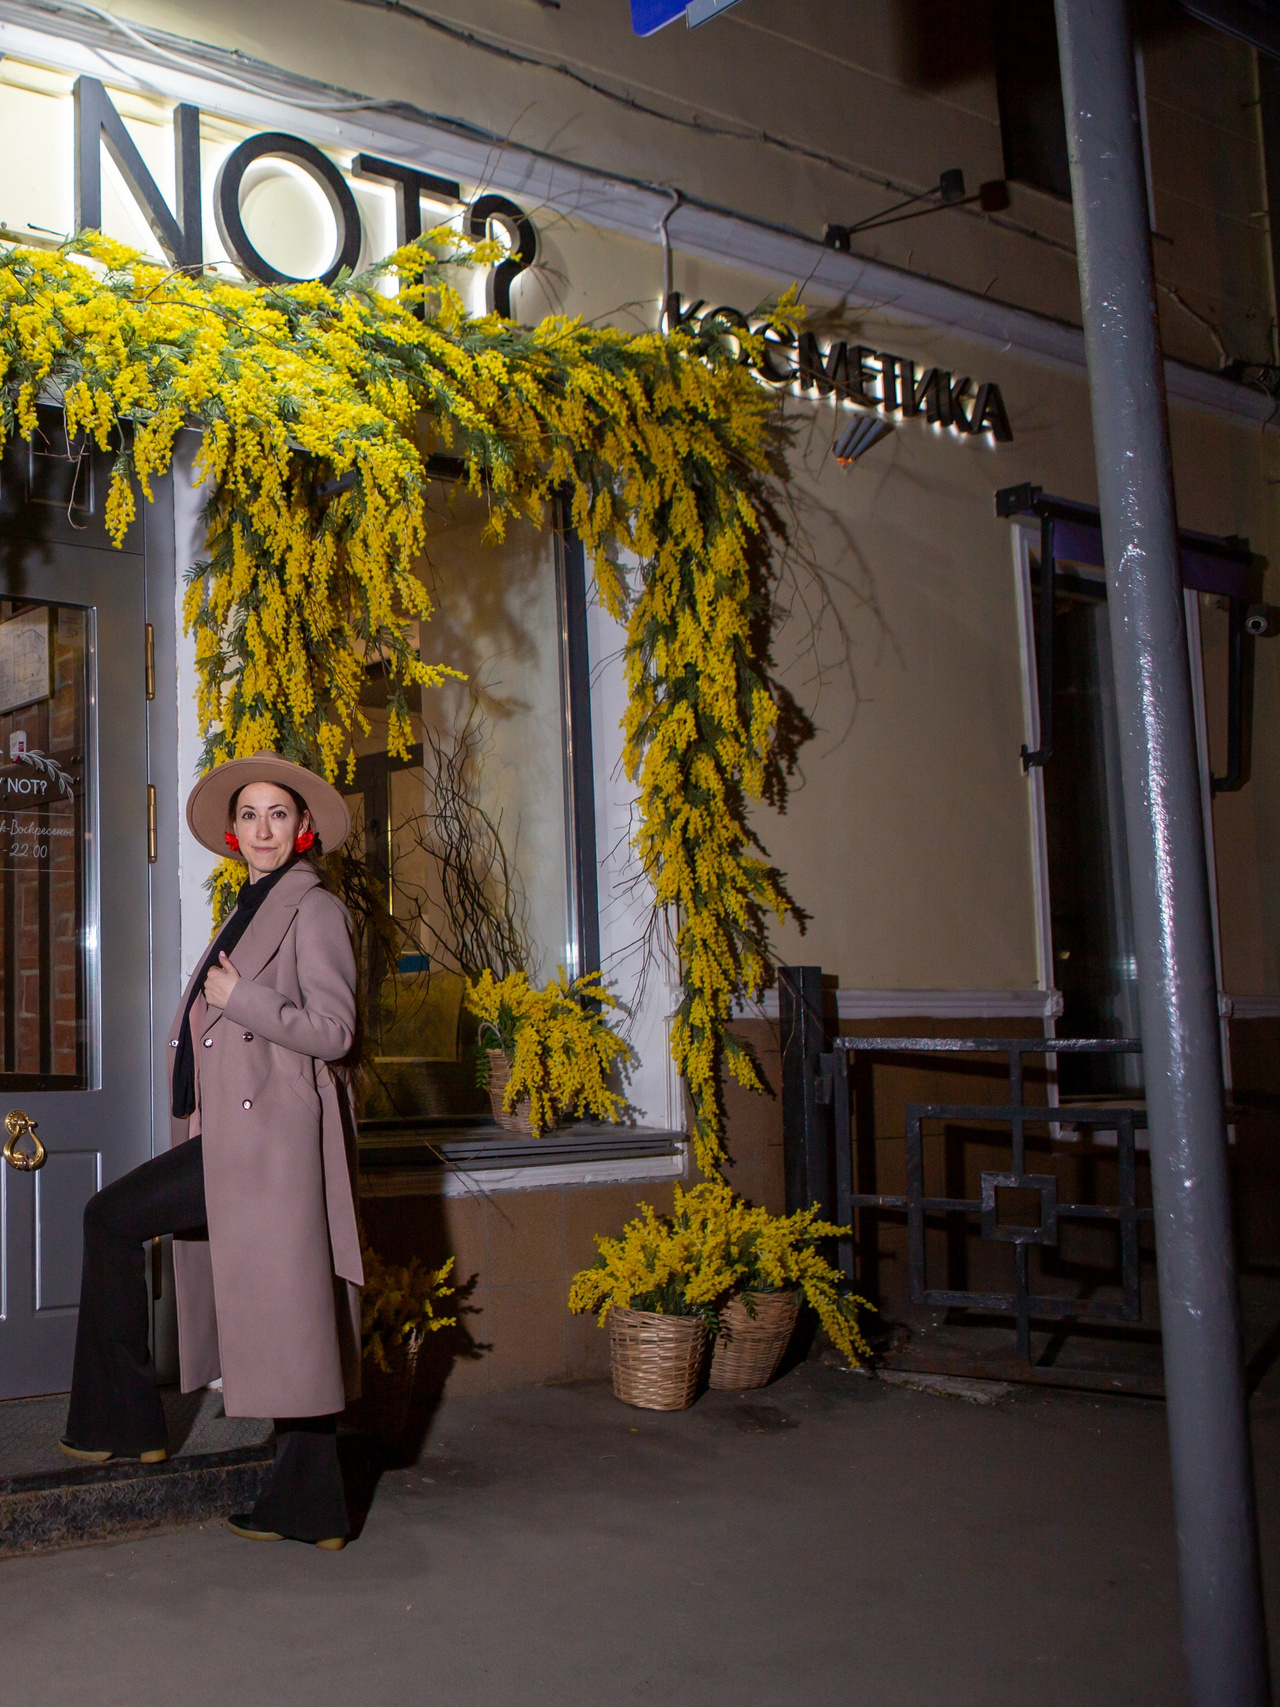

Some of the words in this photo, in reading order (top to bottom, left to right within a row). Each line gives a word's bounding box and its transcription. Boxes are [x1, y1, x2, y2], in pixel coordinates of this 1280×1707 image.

[73, 75, 537, 321] NOT?
[7, 777, 48, 796] NOT?
[9, 842, 48, 859] 22:00
